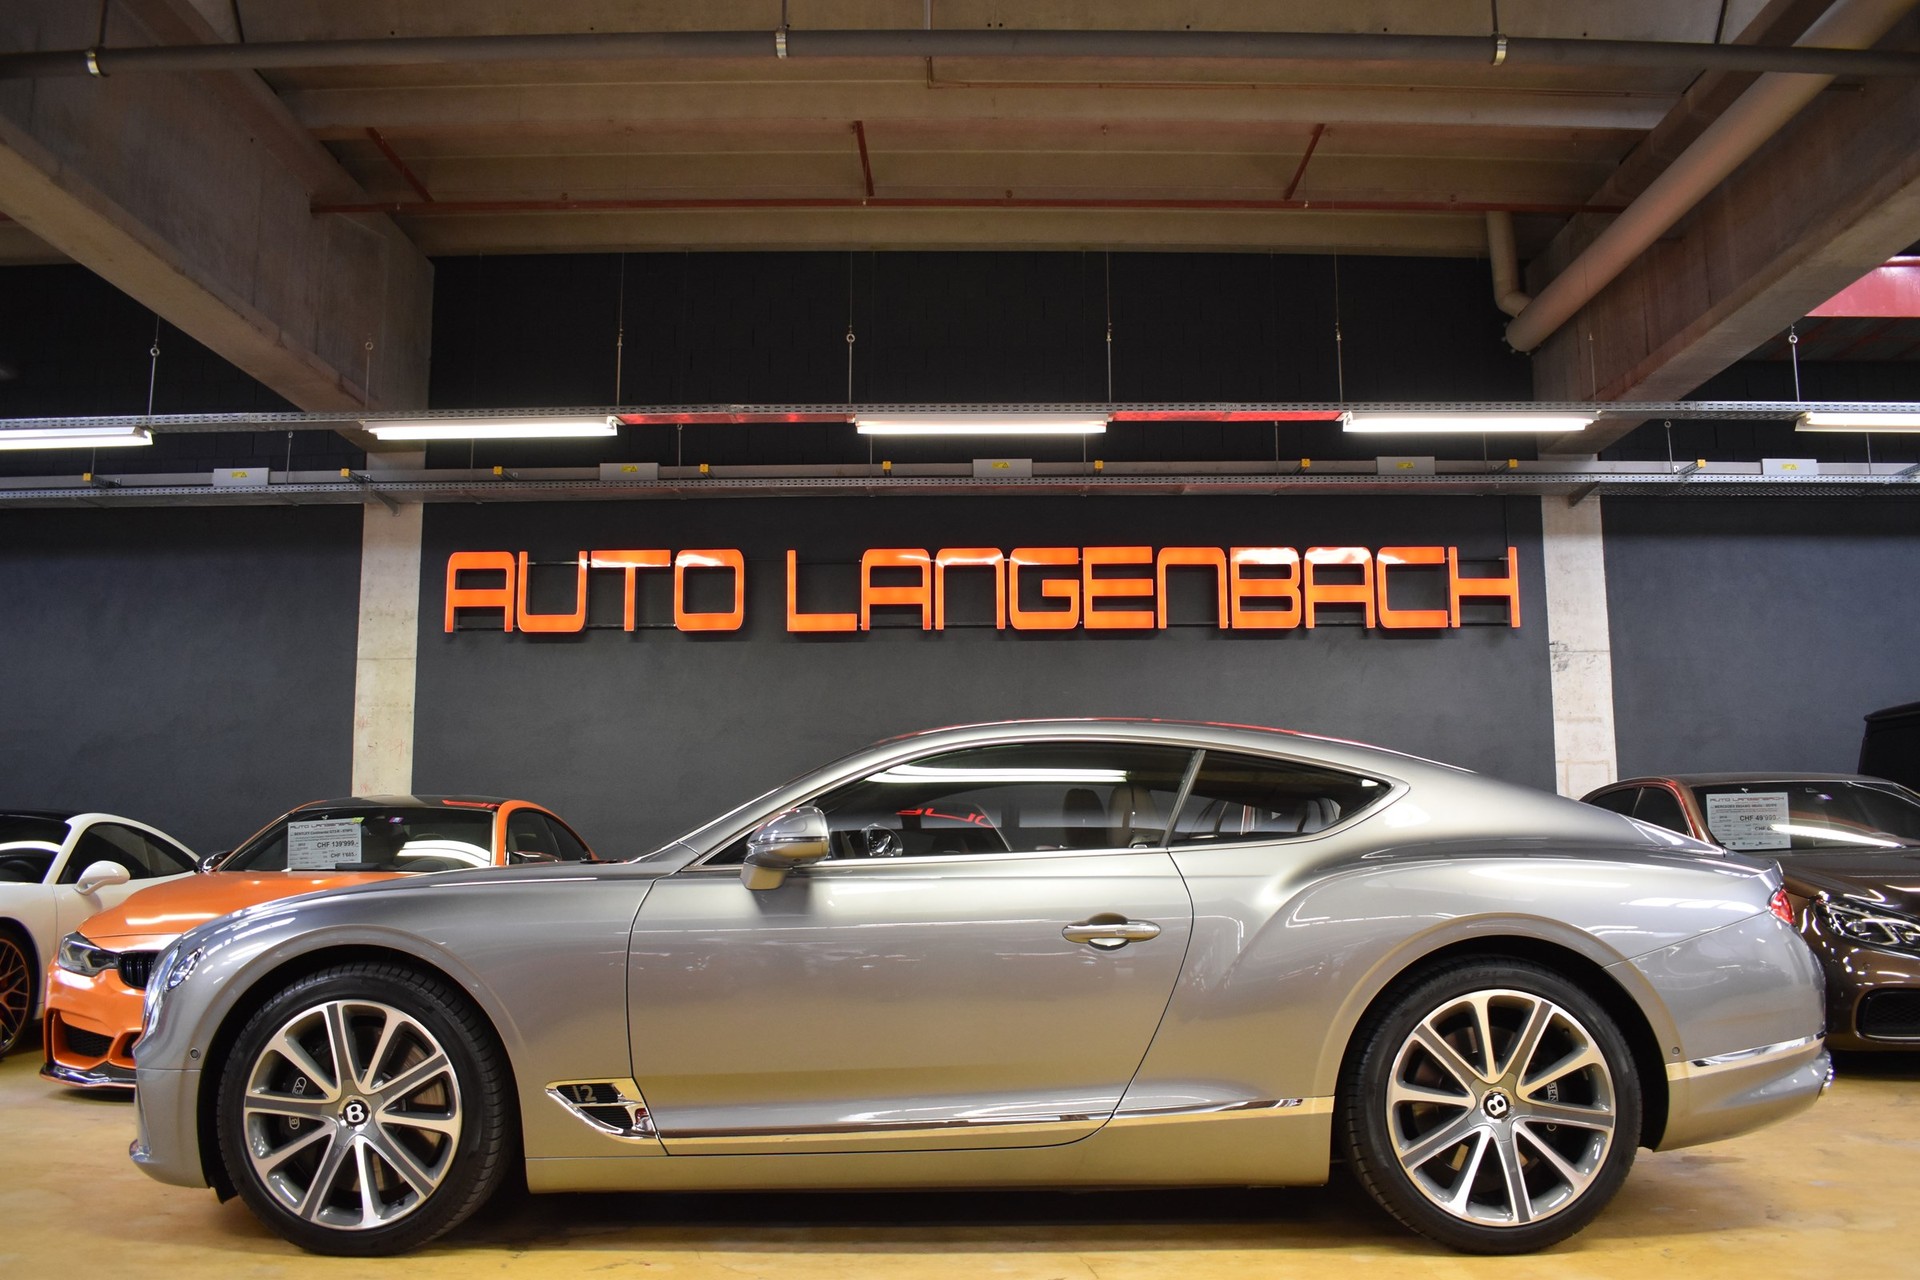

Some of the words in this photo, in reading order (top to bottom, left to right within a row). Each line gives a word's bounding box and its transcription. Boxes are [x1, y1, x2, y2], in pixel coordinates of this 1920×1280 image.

[444, 548, 745, 633] AUTO
[786, 546, 1521, 632] LANGENBACH
[571, 1084, 598, 1103] 12
[345, 1103, 366, 1123] B
[1486, 1094, 1507, 1116] B
